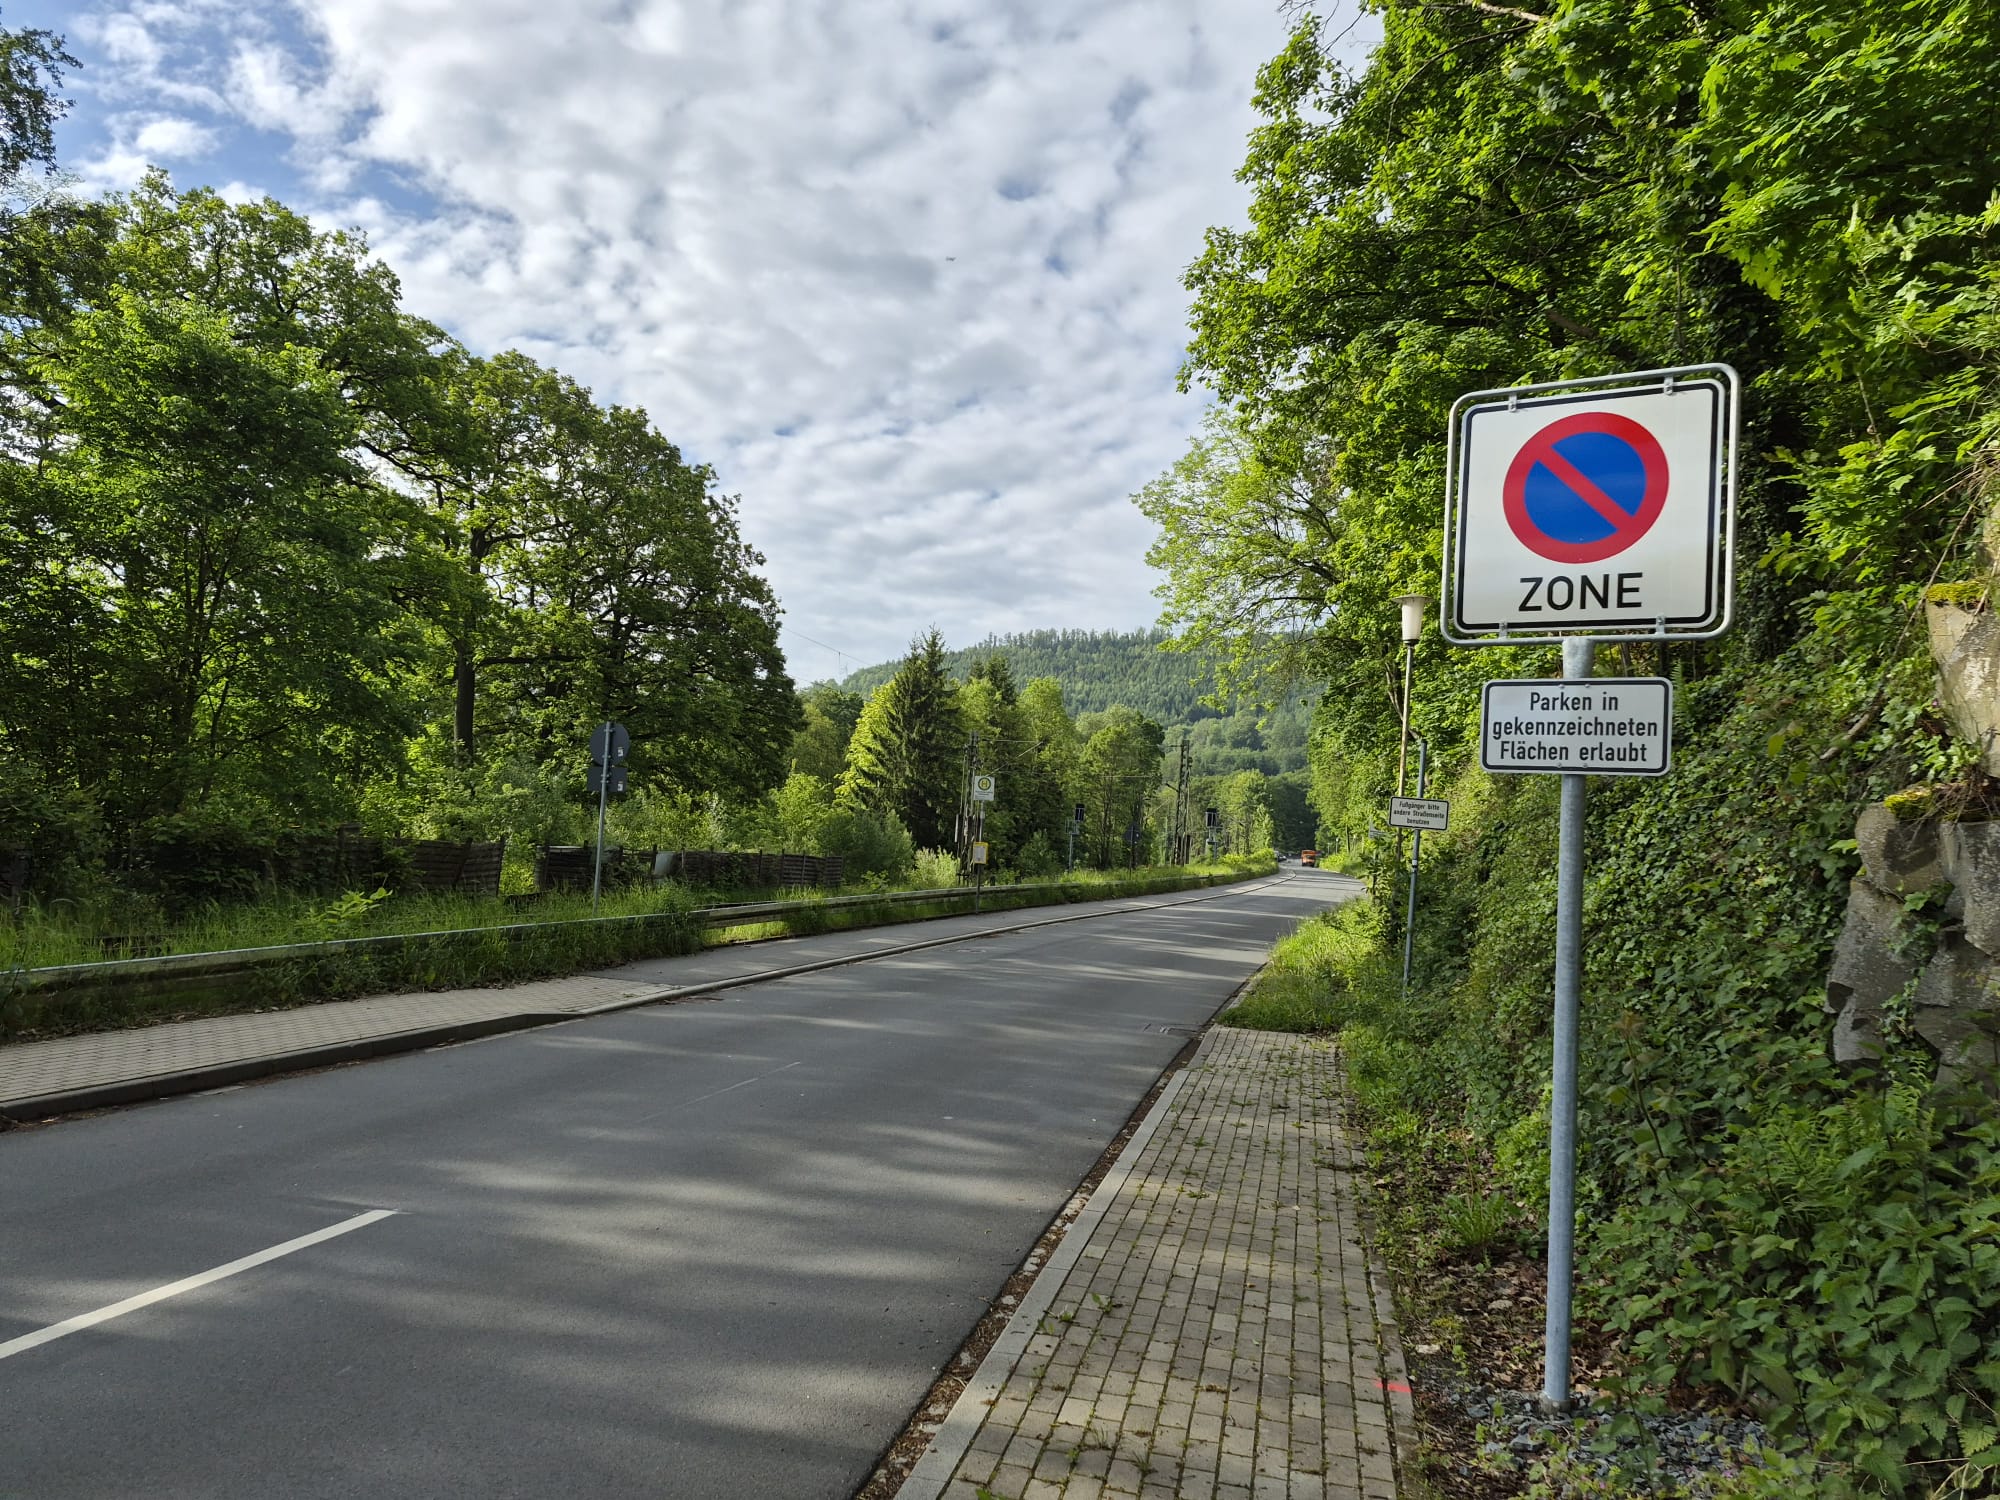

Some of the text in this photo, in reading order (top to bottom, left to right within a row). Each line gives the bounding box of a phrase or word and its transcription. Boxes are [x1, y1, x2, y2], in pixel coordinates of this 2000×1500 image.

[1518, 572, 1643, 612] ZONE
[1530, 691, 1618, 711] Parken in
[1492, 716, 1658, 740] gekennzeichneten
[1500, 740, 1647, 762] Flächen erlaubt
[1399, 801, 1426, 810] Fußgänger
